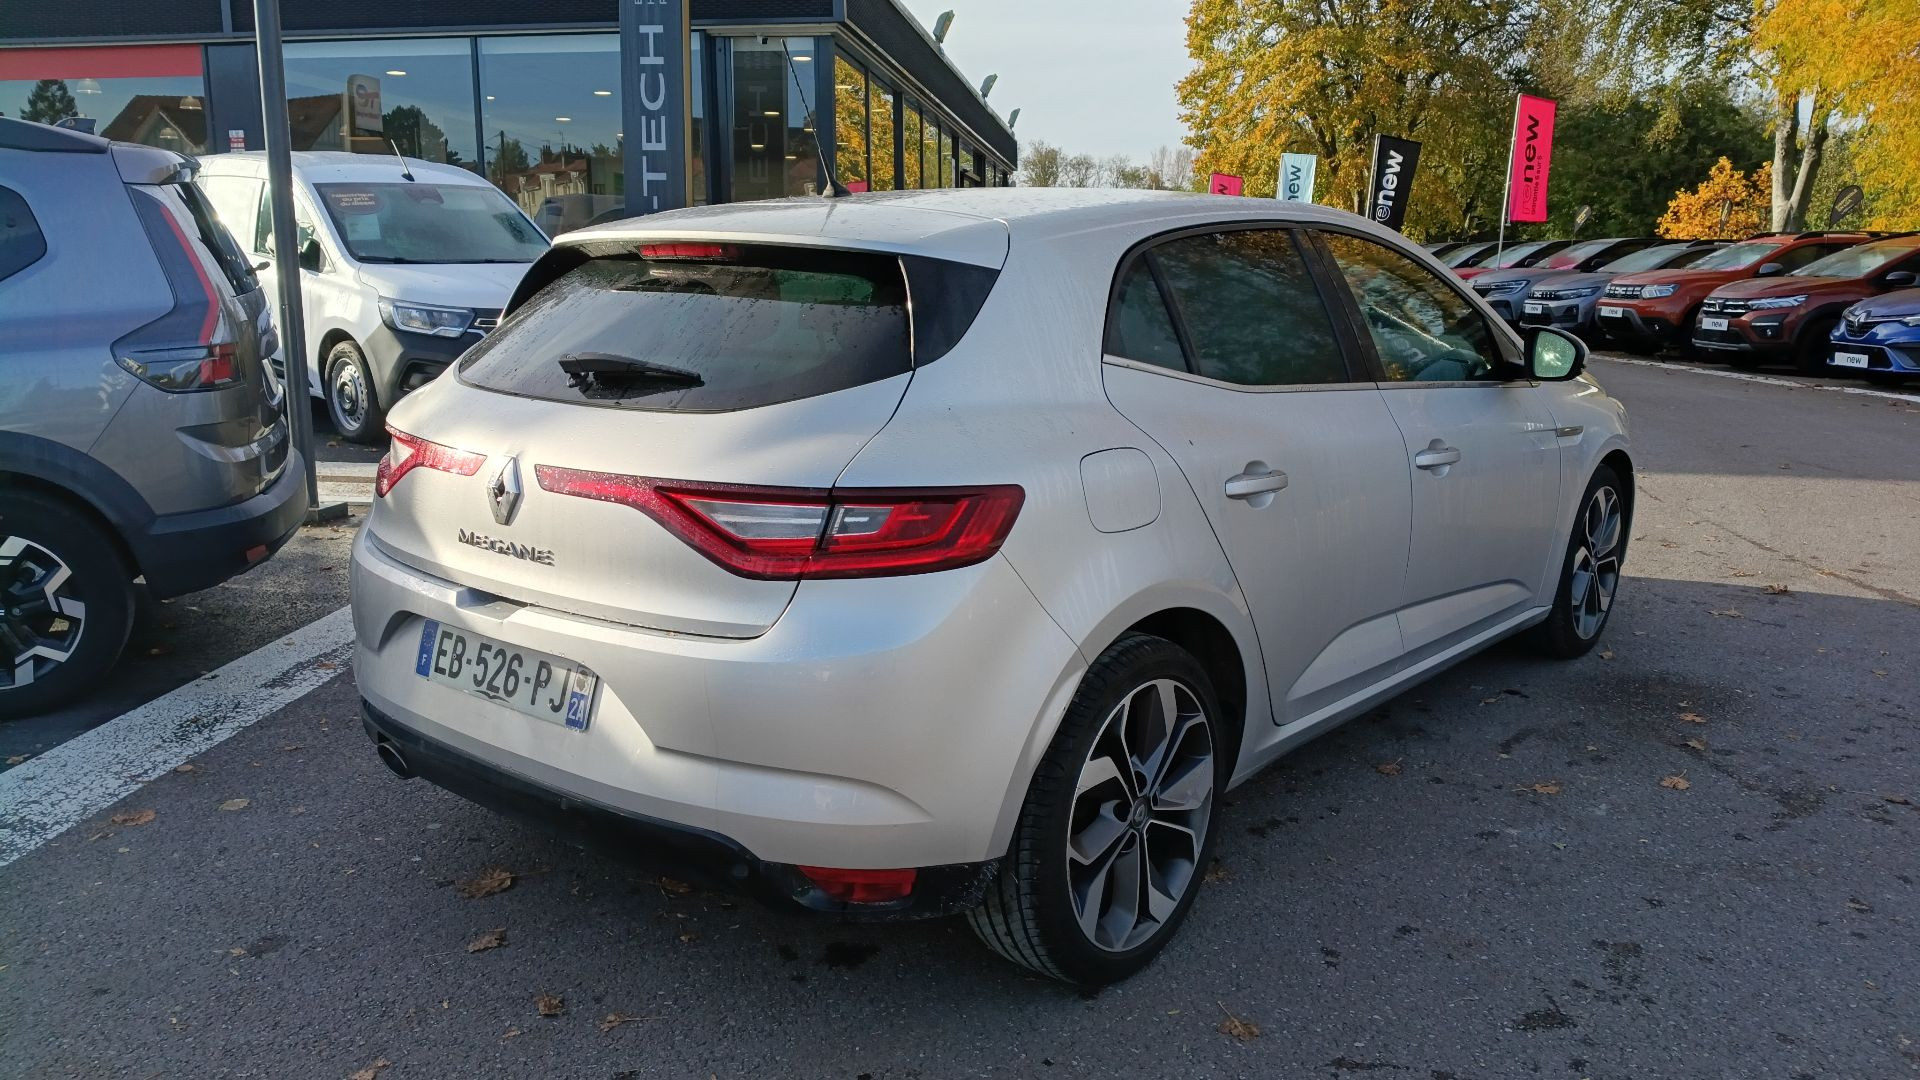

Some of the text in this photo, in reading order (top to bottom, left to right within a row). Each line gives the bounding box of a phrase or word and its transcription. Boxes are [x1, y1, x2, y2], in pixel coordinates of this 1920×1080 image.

[1375, 149, 1404, 221] enew
[1523, 114, 1539, 215] renew
[458, 528, 555, 567] MEGANE
[421, 653, 428, 667] F
[433, 630, 572, 712] EB-526-PJ
[568, 697, 585, 722] 2A
